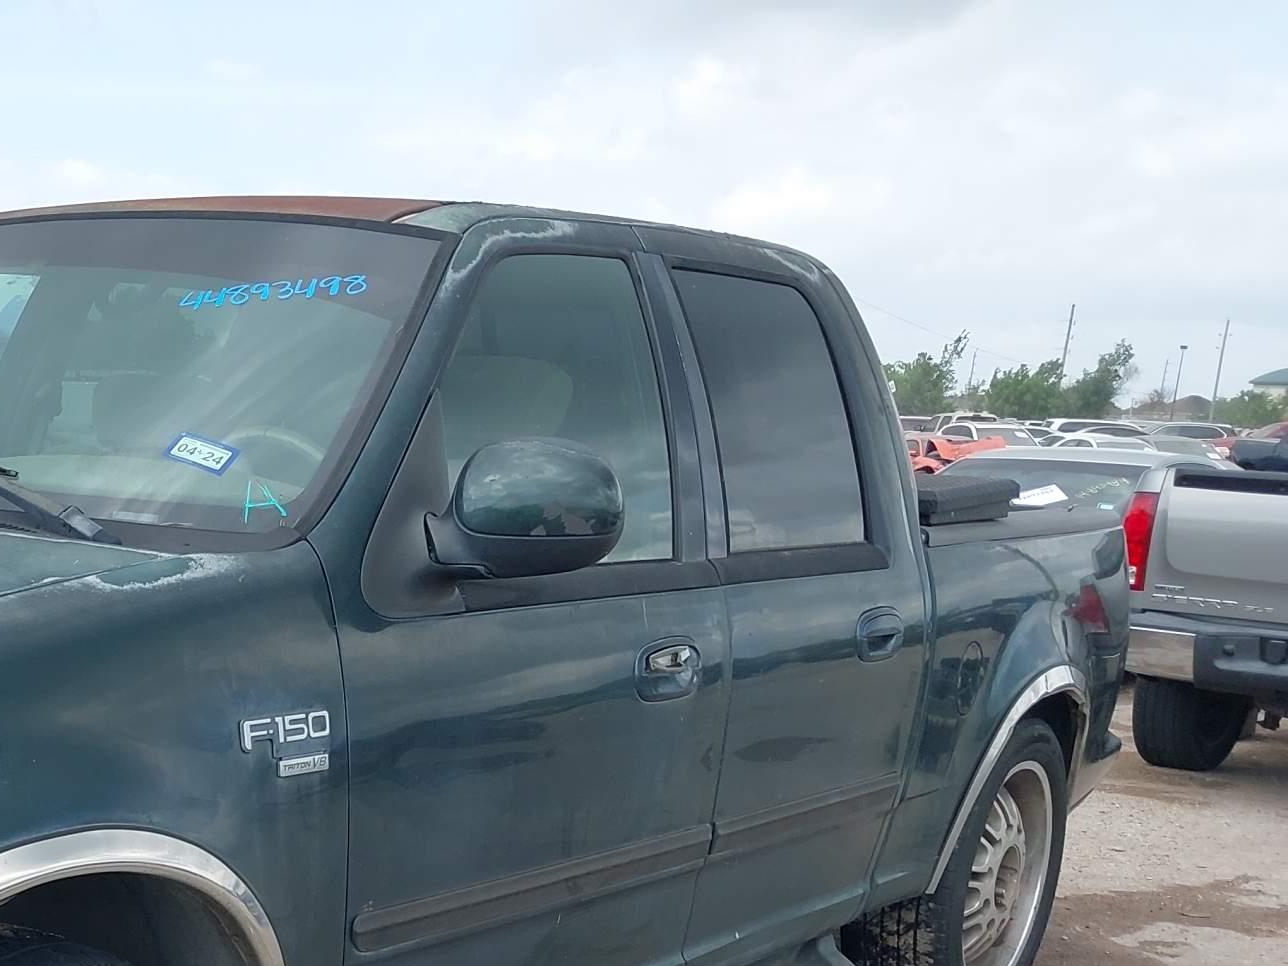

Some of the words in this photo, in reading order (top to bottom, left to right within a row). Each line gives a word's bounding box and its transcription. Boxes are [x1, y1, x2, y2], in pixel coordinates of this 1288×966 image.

[179, 275, 368, 310] 44893498
[177, 443, 198, 455] 04
[202, 451, 224, 465] 24
[244, 480, 288, 524] A
[312, 756, 327, 769] V8
